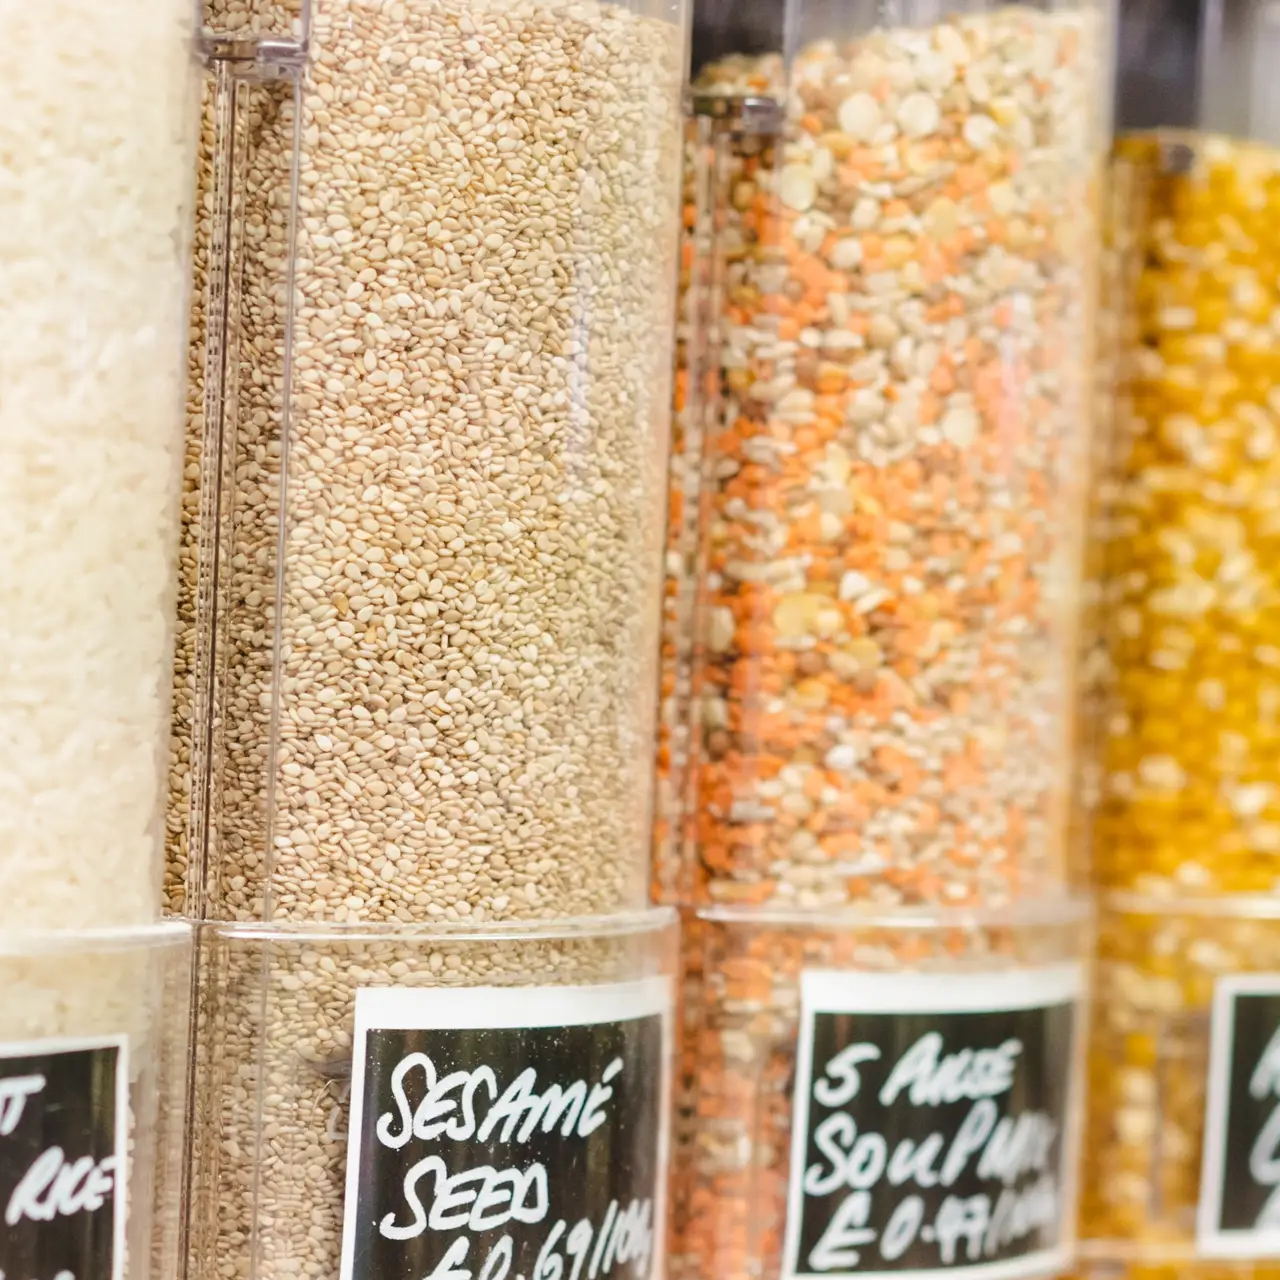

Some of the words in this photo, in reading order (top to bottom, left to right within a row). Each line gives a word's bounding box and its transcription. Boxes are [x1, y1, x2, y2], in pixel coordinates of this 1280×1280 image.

[813, 1041, 881, 1107] 5
[5, 1145, 117, 1226] RICE
[379, 1155, 550, 1240] SEED
